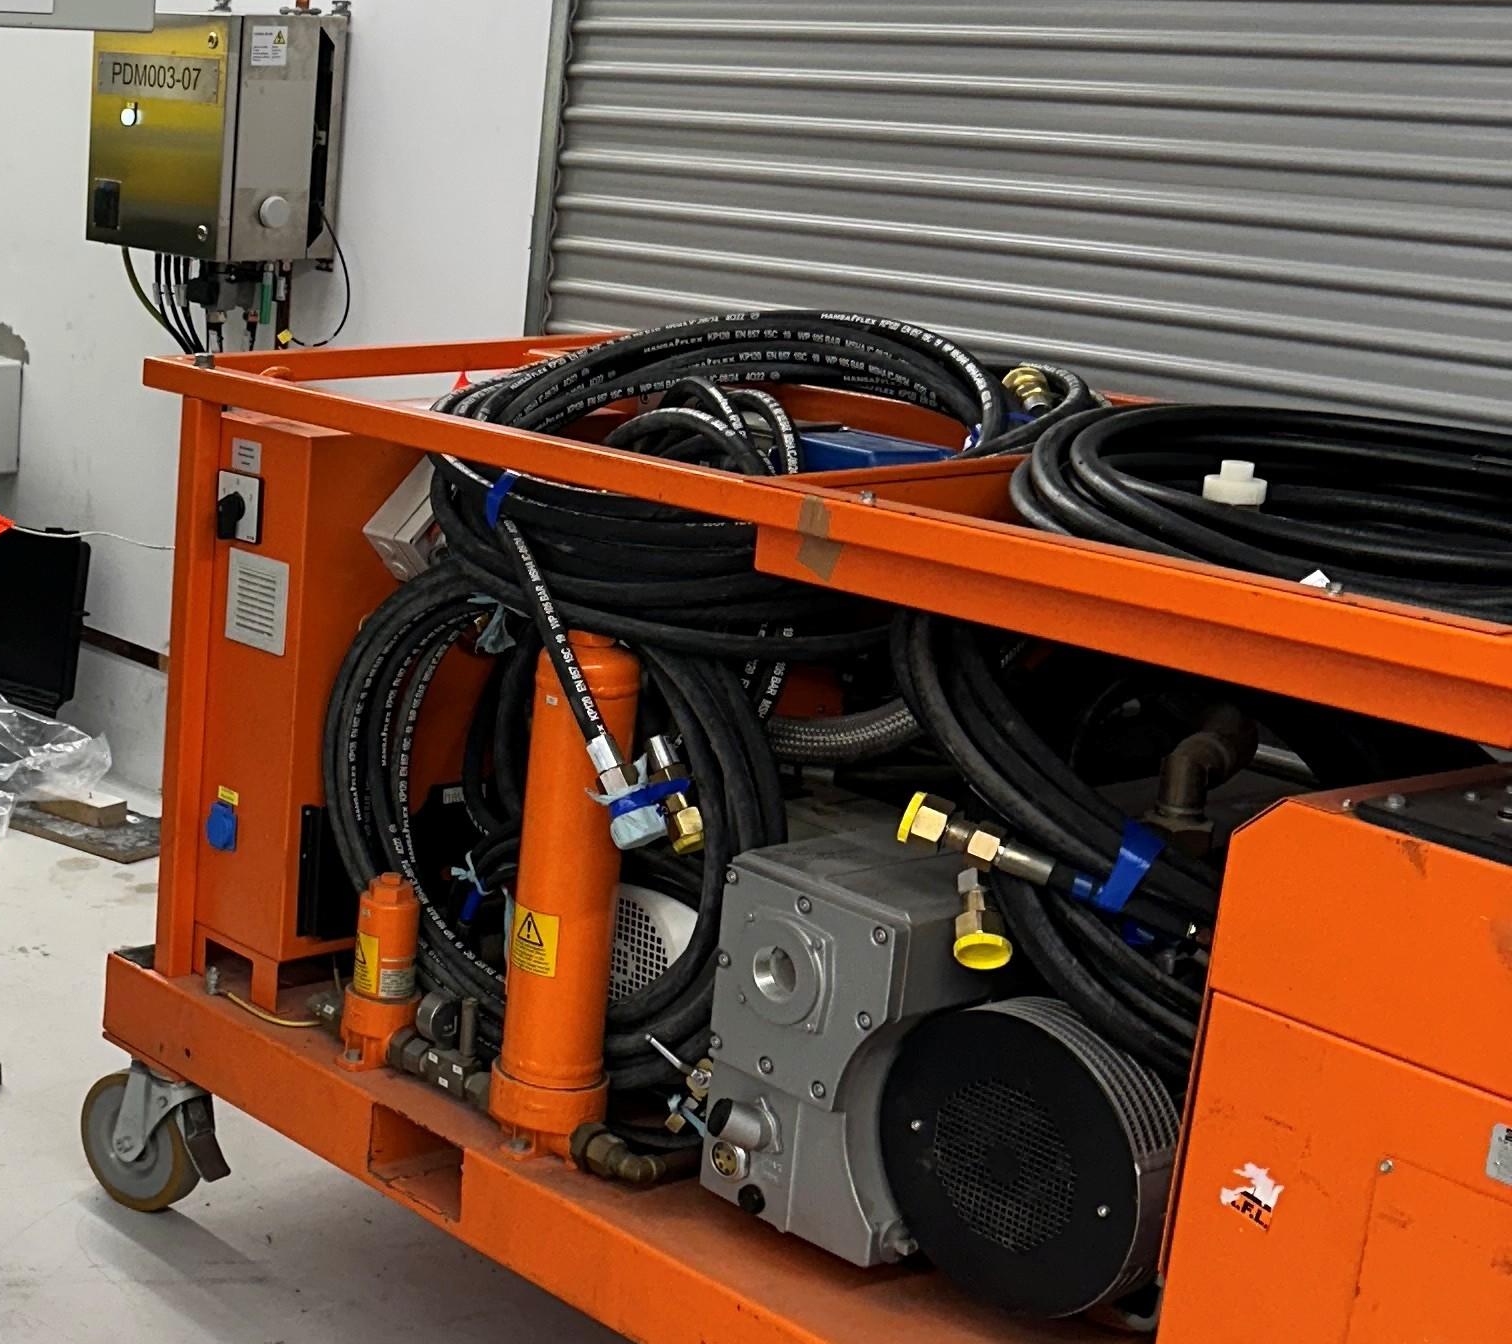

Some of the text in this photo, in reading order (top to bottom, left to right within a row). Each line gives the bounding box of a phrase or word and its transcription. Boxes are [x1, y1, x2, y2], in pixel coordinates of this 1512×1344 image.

[111, 61, 202, 92] PDM003-07
[535, 584, 550, 602] BAR
[547, 615, 561, 630] WP
[560, 647, 575, 664] 1SC
[567, 666, 581, 680] 857
[574, 679, 587, 693] EN
[766, 675, 783, 696] BAR
[581, 695, 599, 722] KP120
